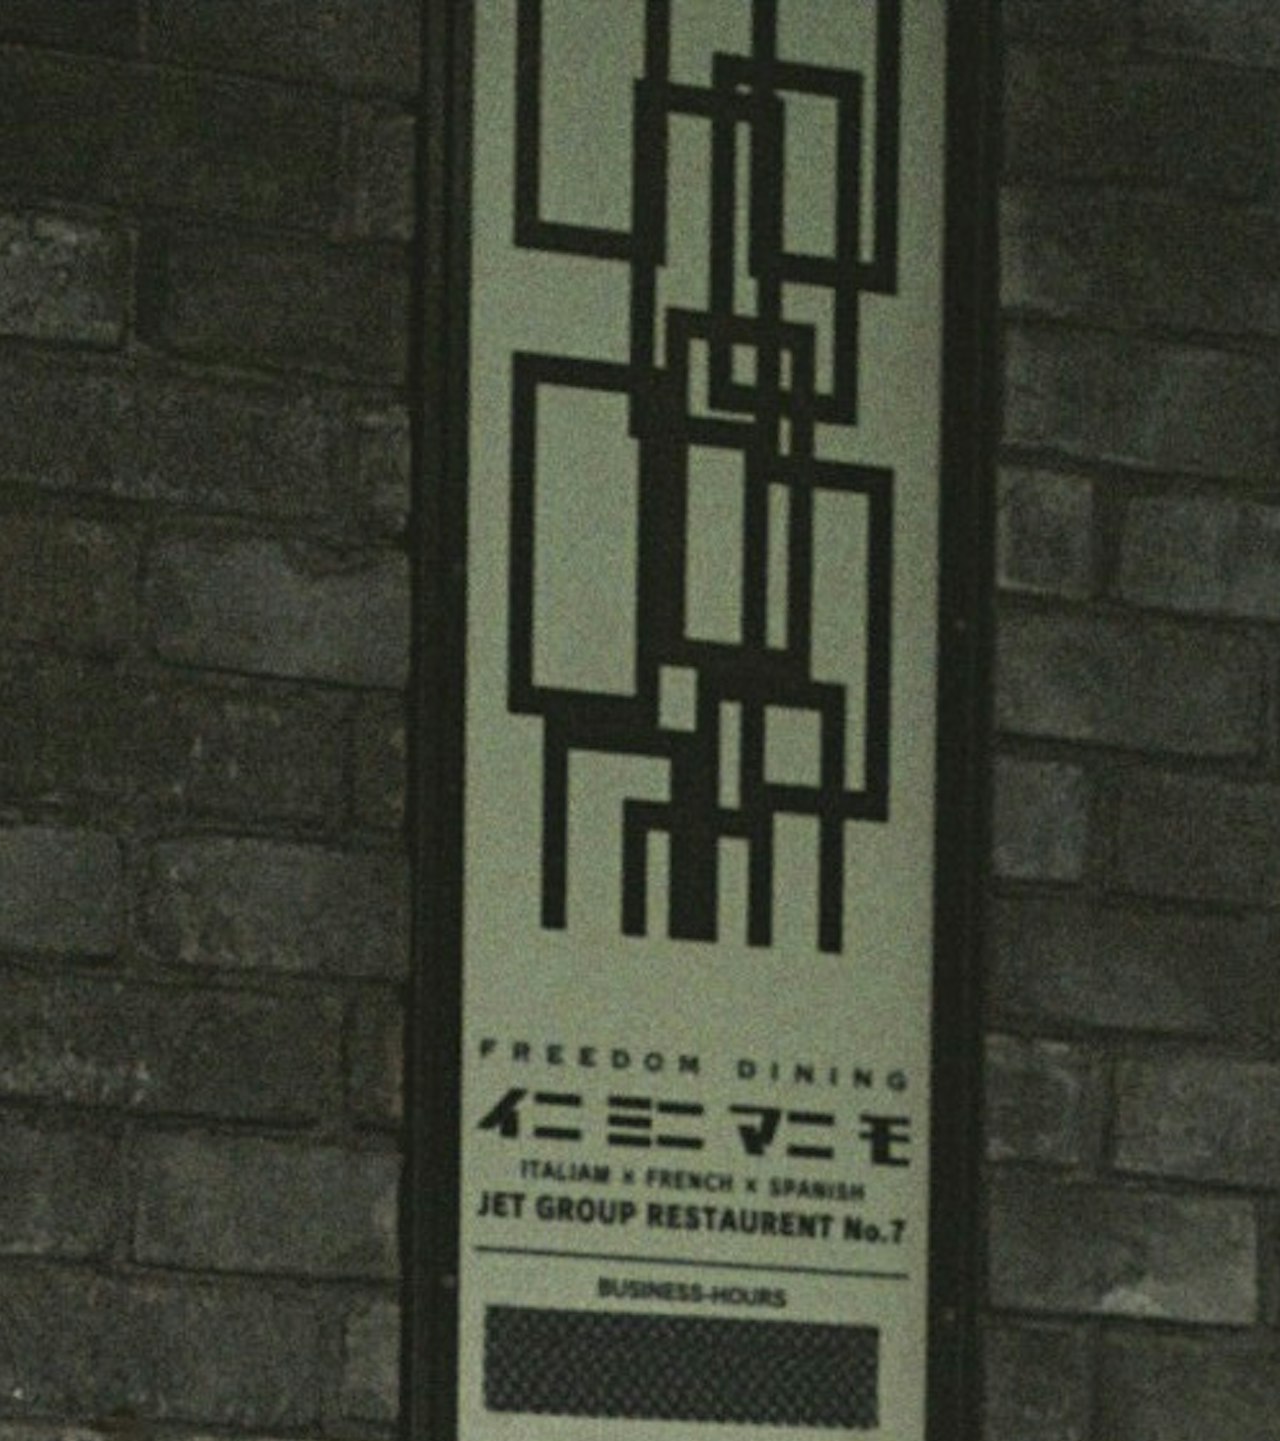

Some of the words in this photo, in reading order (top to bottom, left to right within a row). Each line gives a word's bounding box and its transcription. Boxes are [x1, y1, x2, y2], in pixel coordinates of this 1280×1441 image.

[480, 1038, 700, 1075] FREEDOM
[737, 1058, 908, 1092] DINING
[646, 1166, 733, 1194] FRENCH
[769, 1176, 866, 1201] SPANISH
[477, 1190, 525, 1218] JET
[534, 1194, 637, 1225] GROUP
[646, 1202, 834, 1238] RESTAURENT
[843, 1213, 907, 1244] No.7
